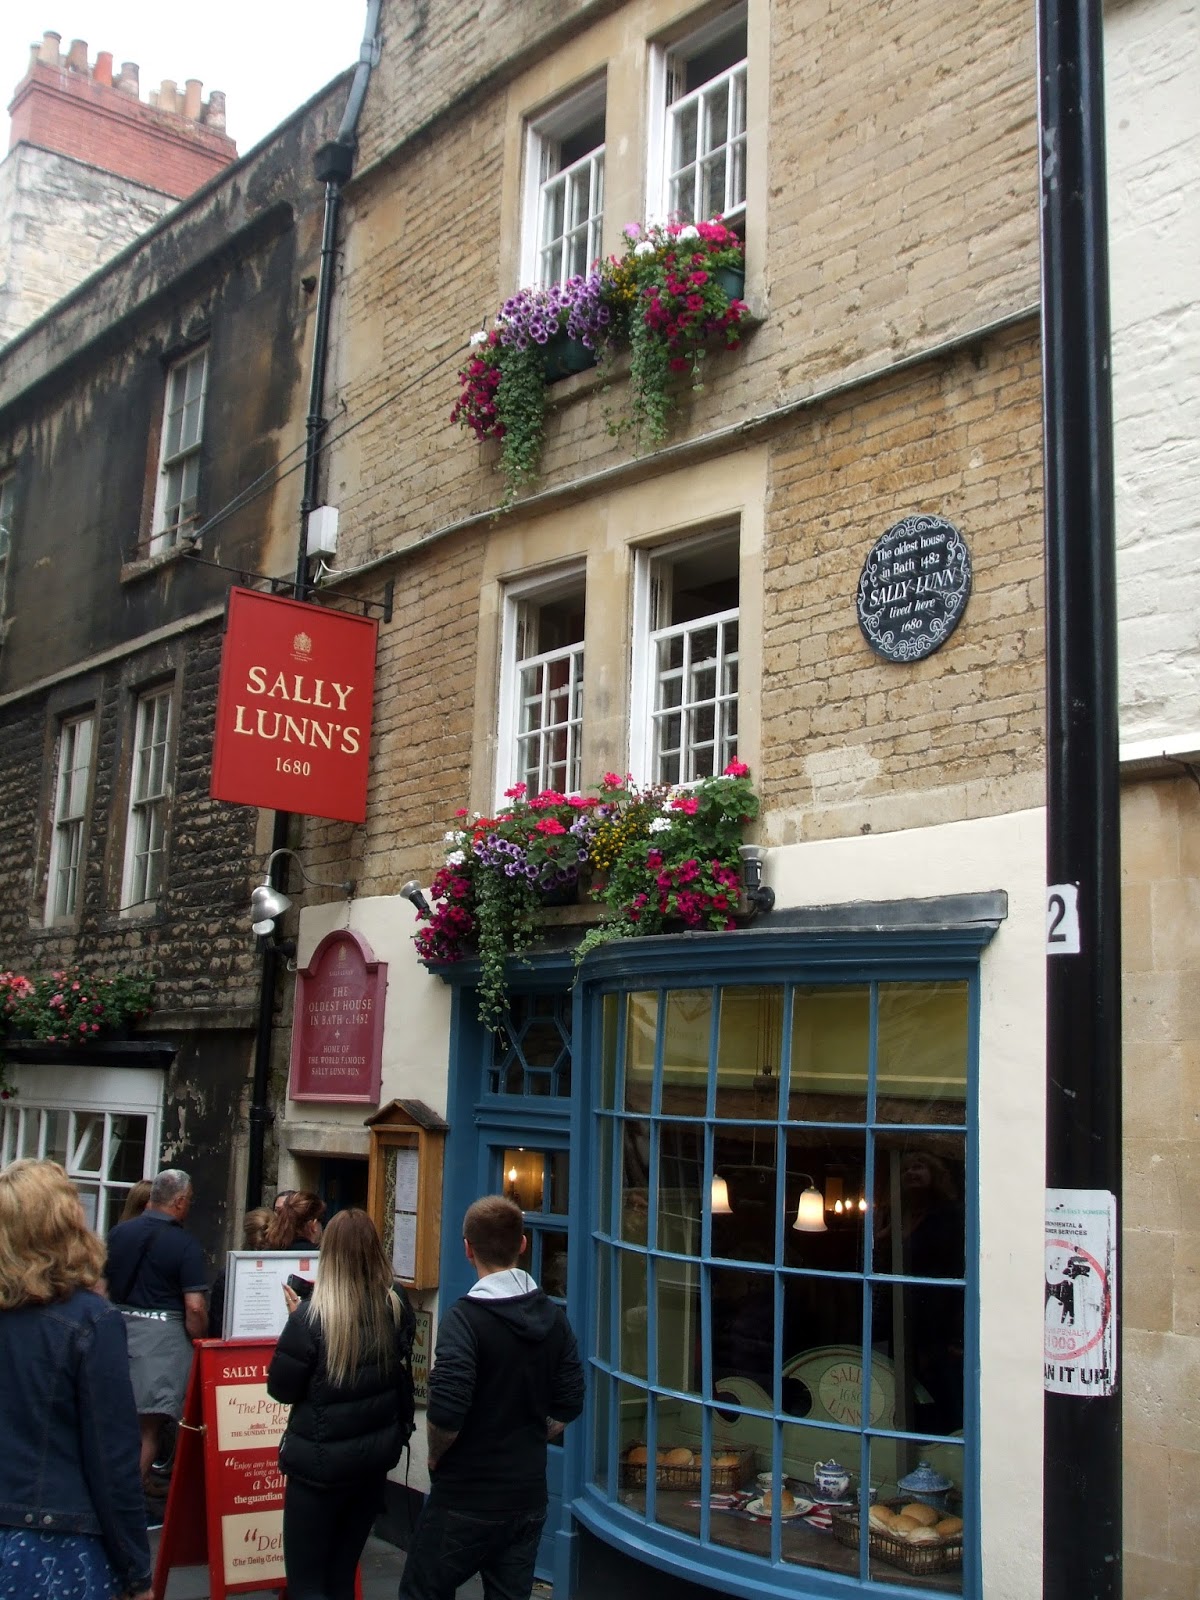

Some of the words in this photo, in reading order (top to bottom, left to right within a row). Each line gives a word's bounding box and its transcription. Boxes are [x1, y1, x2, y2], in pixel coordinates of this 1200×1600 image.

[875, 548, 893, 562] The
[894, 539, 918, 557] oldest
[920, 533, 946, 549] house
[882, 566, 891, 578] in
[893, 558, 915, 575] Bath
[920, 552, 940, 569] 1482
[869, 579, 912, 607] SALLY
[915, 567, 957, 595] LUNN
[889, 603, 911, 619] lived
[914, 598, 936, 613] here
[901, 618, 923, 633] 1680
[246, 666, 354, 711] SALLY
[233, 705, 361, 754] LUNN'S
[275, 757, 311, 776] 1680
[1047, 893, 1067, 943] 2
[333, 986, 349, 998] THE
[309, 1001, 340, 1012] OLDEST
[342, 999, 372, 1011] HOUSE
[310, 1015, 319, 1026] IN
[322, 1014, 343, 1025] BATH
[323, 1045, 340, 1053] HOME
[341, 1045, 350, 1053] OF
[308, 1056, 319, 1064] THE
[320, 1056, 340, 1064] WORLD
[341, 1056, 366, 1065] FAMOUS
[311, 1067, 328, 1076] SALLY
[222, 1366, 258, 1378] SALLY
[1060, 1366, 1075, 1383] IT
[244, 1429, 266, 1437] SUNDAY
[253, 1461, 265, 1470] any
[253, 1469, 267, 1477] long
[252, 1480, 260, 1490] a
[232, 1558, 246, 1567] The
[247, 1556, 265, 1565] Daily
